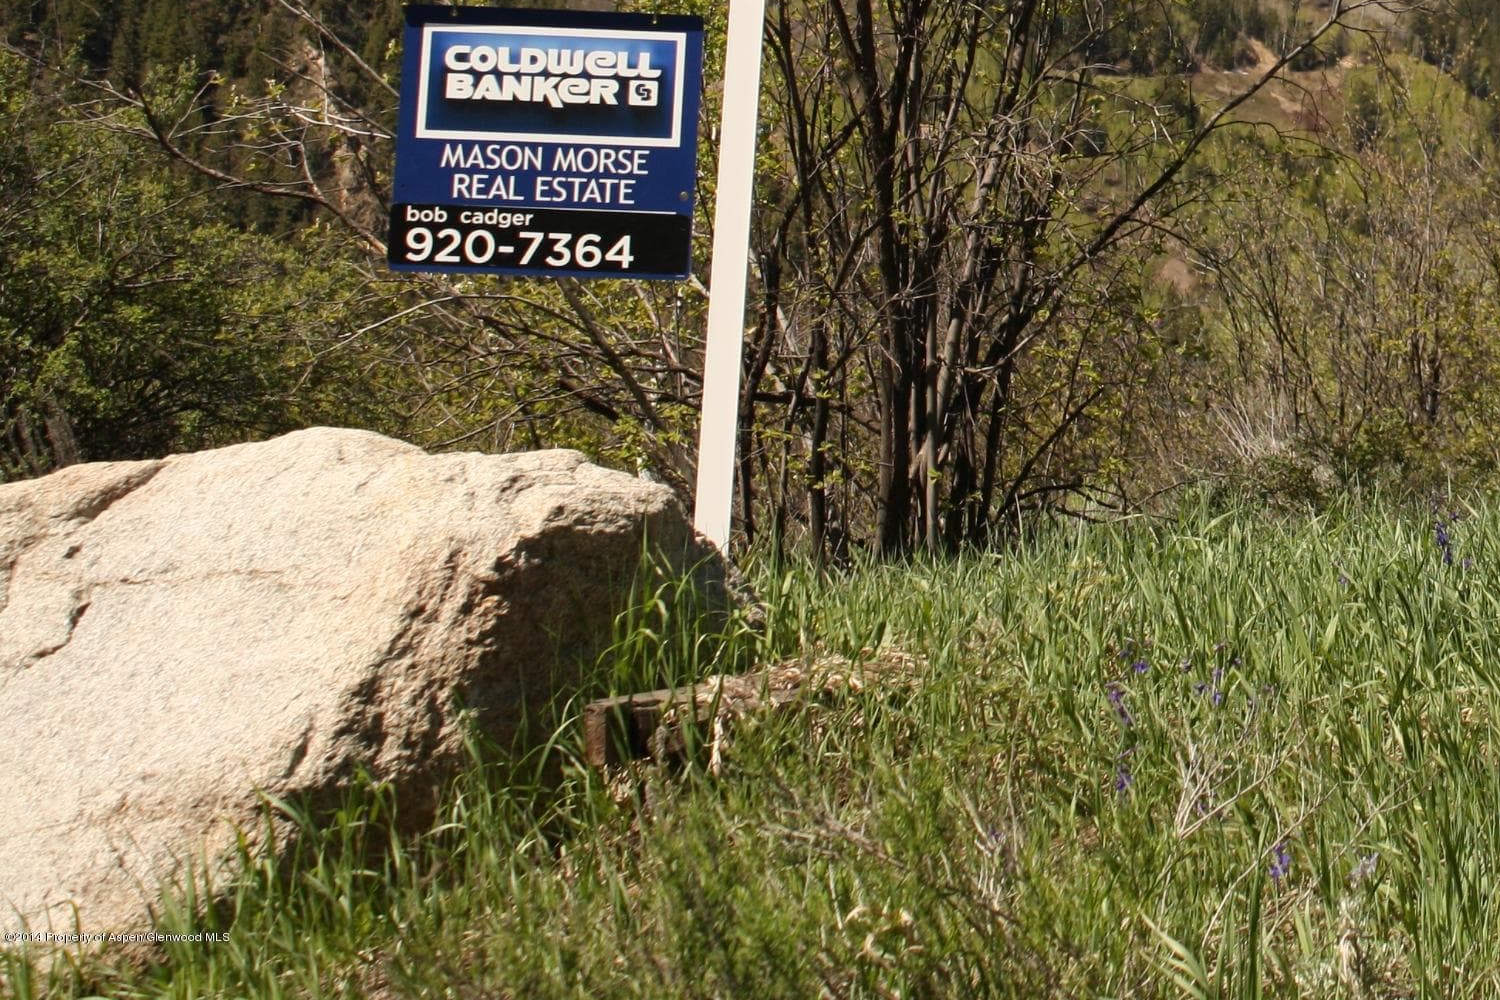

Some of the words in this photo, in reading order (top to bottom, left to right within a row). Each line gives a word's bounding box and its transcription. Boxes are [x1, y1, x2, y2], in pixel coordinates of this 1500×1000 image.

[440, 144, 542, 171] MASON
[553, 147, 650, 175] MORSE
[452, 175, 524, 201] REAL
[535, 177, 636, 204] ESTATE
[406, 206, 447, 223] bob
[460, 210, 533, 228] cadger
[405, 227, 634, 269] 920-7364
